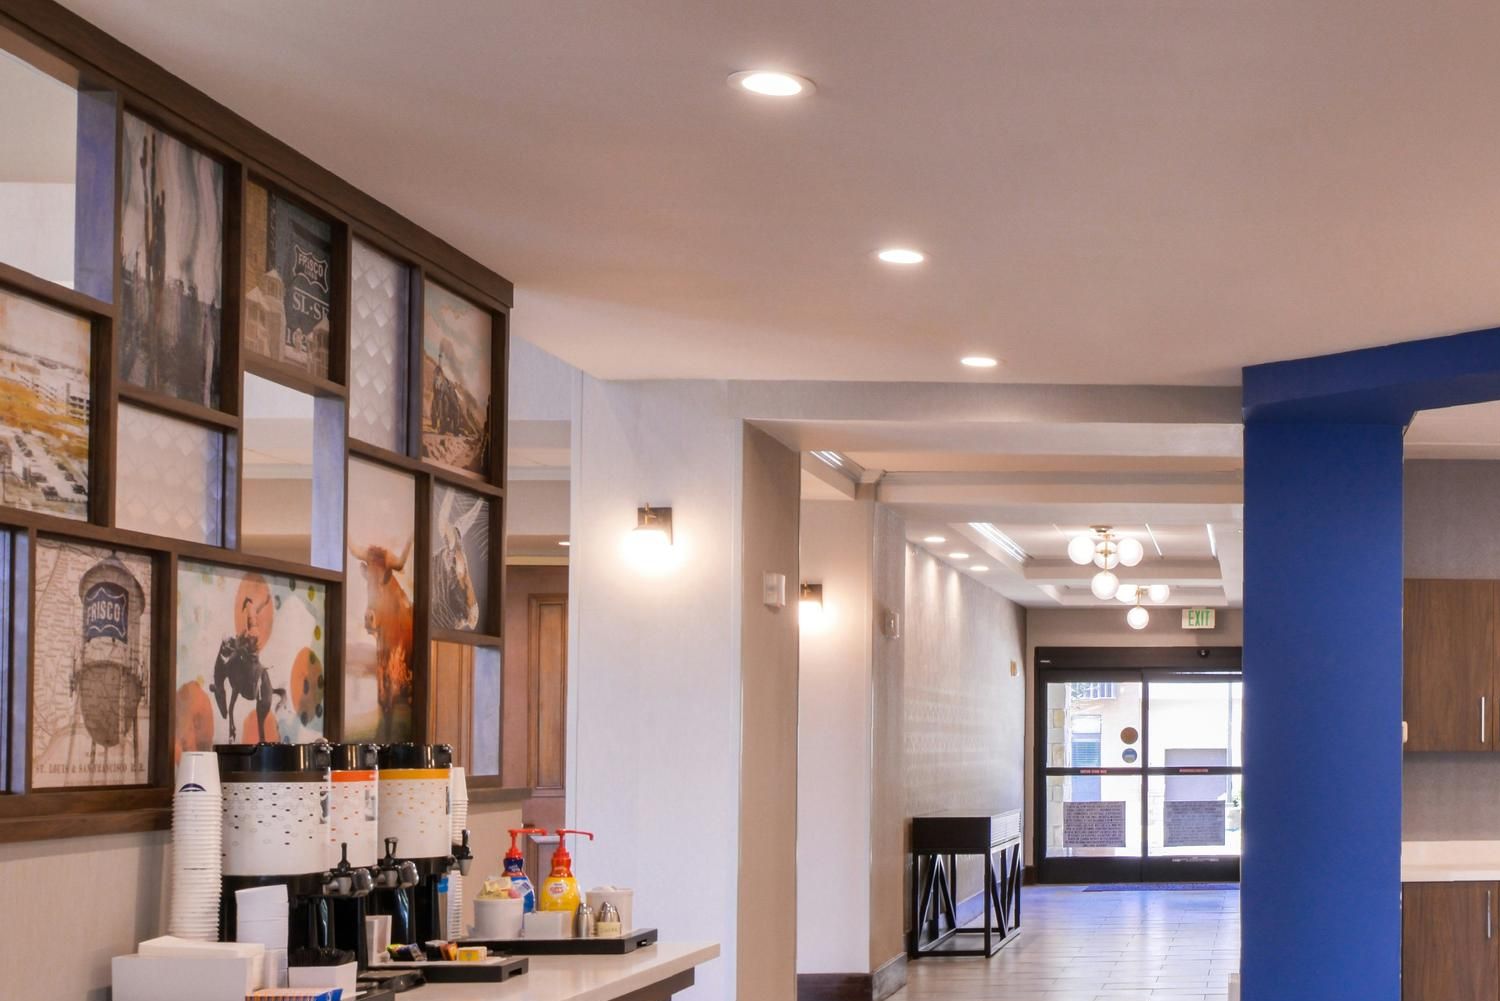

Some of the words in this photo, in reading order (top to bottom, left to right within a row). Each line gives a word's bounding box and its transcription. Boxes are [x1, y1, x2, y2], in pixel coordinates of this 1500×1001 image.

[298, 253, 324, 278] FRISCO
[86, 600, 121, 626] FRISCO
[1188, 610, 1210, 626] EXIT
